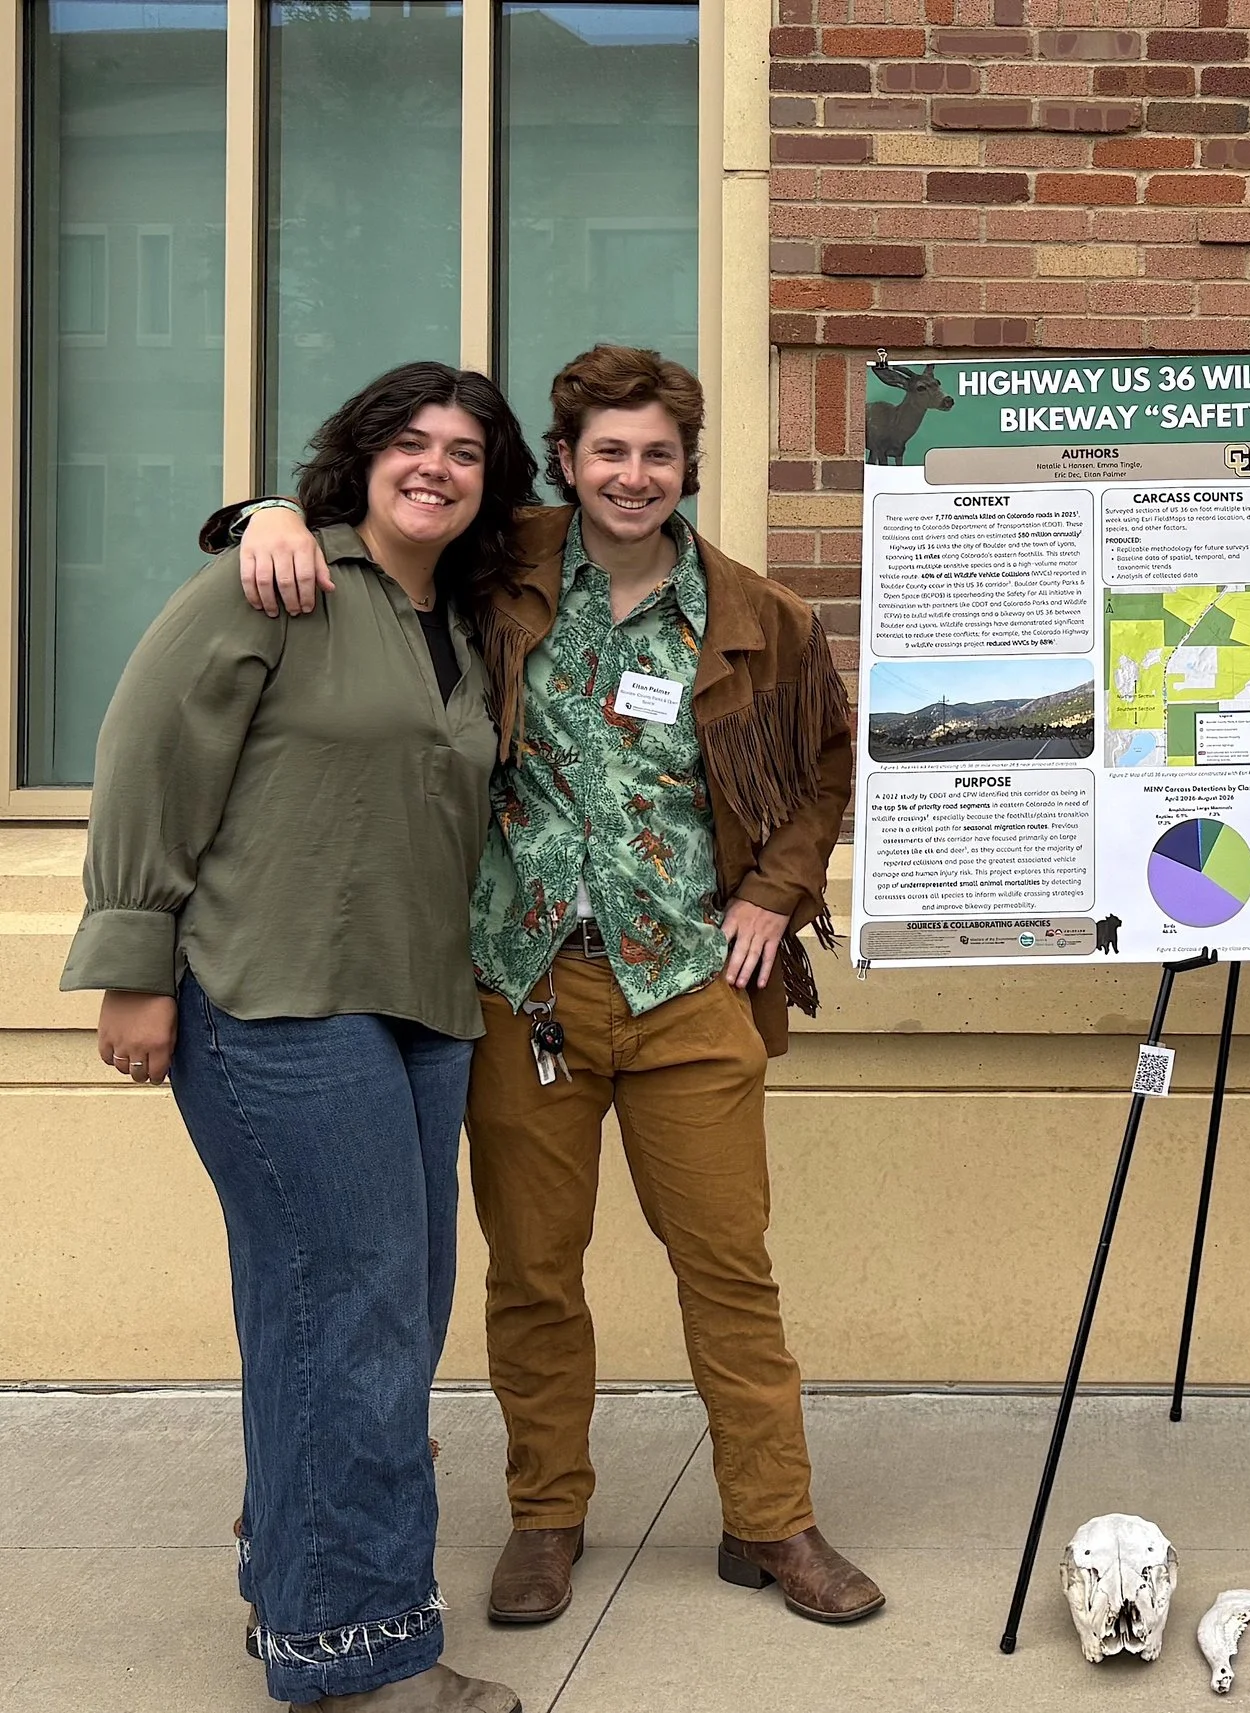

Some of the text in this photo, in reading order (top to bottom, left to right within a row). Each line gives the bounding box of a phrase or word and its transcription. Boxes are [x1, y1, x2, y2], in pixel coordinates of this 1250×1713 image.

[959, 368, 1105, 395] HIGHWAY
[1112, 367, 1150, 392] US
[1158, 366, 1195, 391] 36
[1000, 405, 1138, 431] BIKEWAY
[1061, 448, 1119, 459] AUTHORS
[953, 496, 1010, 506] CONTEXT
[1133, 491, 1243, 503] CARCASS COUNTS
[954, 776, 1011, 788] PURPOSE
[906, 919, 1050, 930] SOURCES & COLLABORATING AGENCIES
